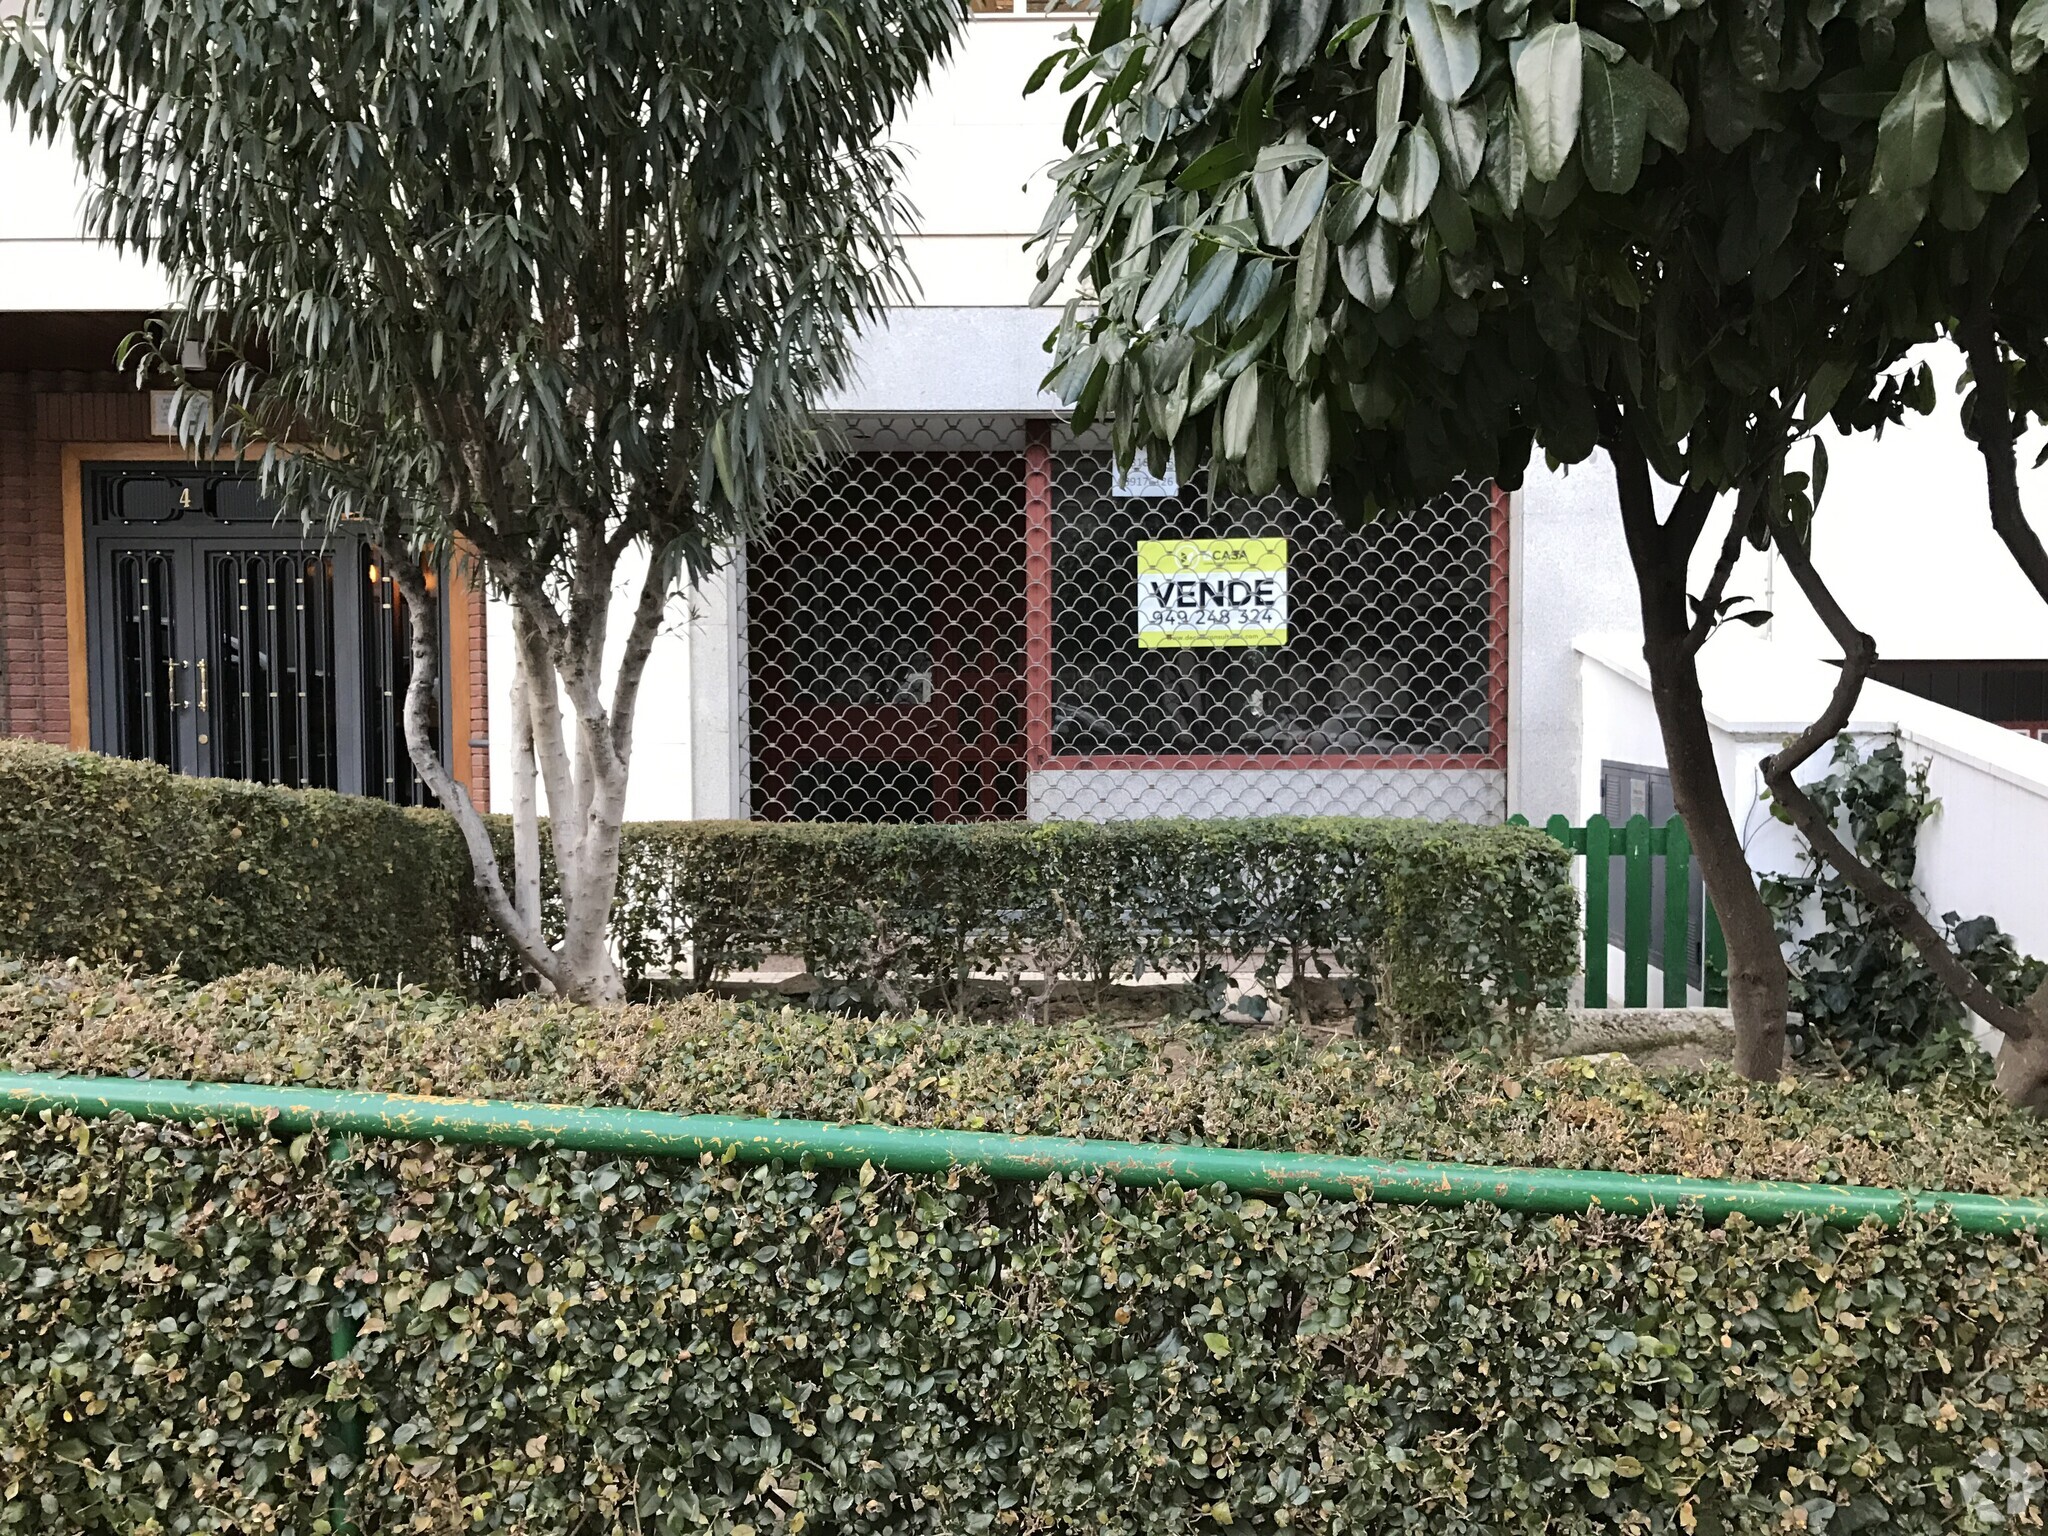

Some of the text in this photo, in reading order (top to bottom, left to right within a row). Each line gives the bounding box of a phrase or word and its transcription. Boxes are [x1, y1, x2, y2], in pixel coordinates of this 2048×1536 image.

[179, 487, 191, 508] 4
[1151, 579, 1275, 608] VENDE
[1152, 608, 1272, 625] 949 248 324
